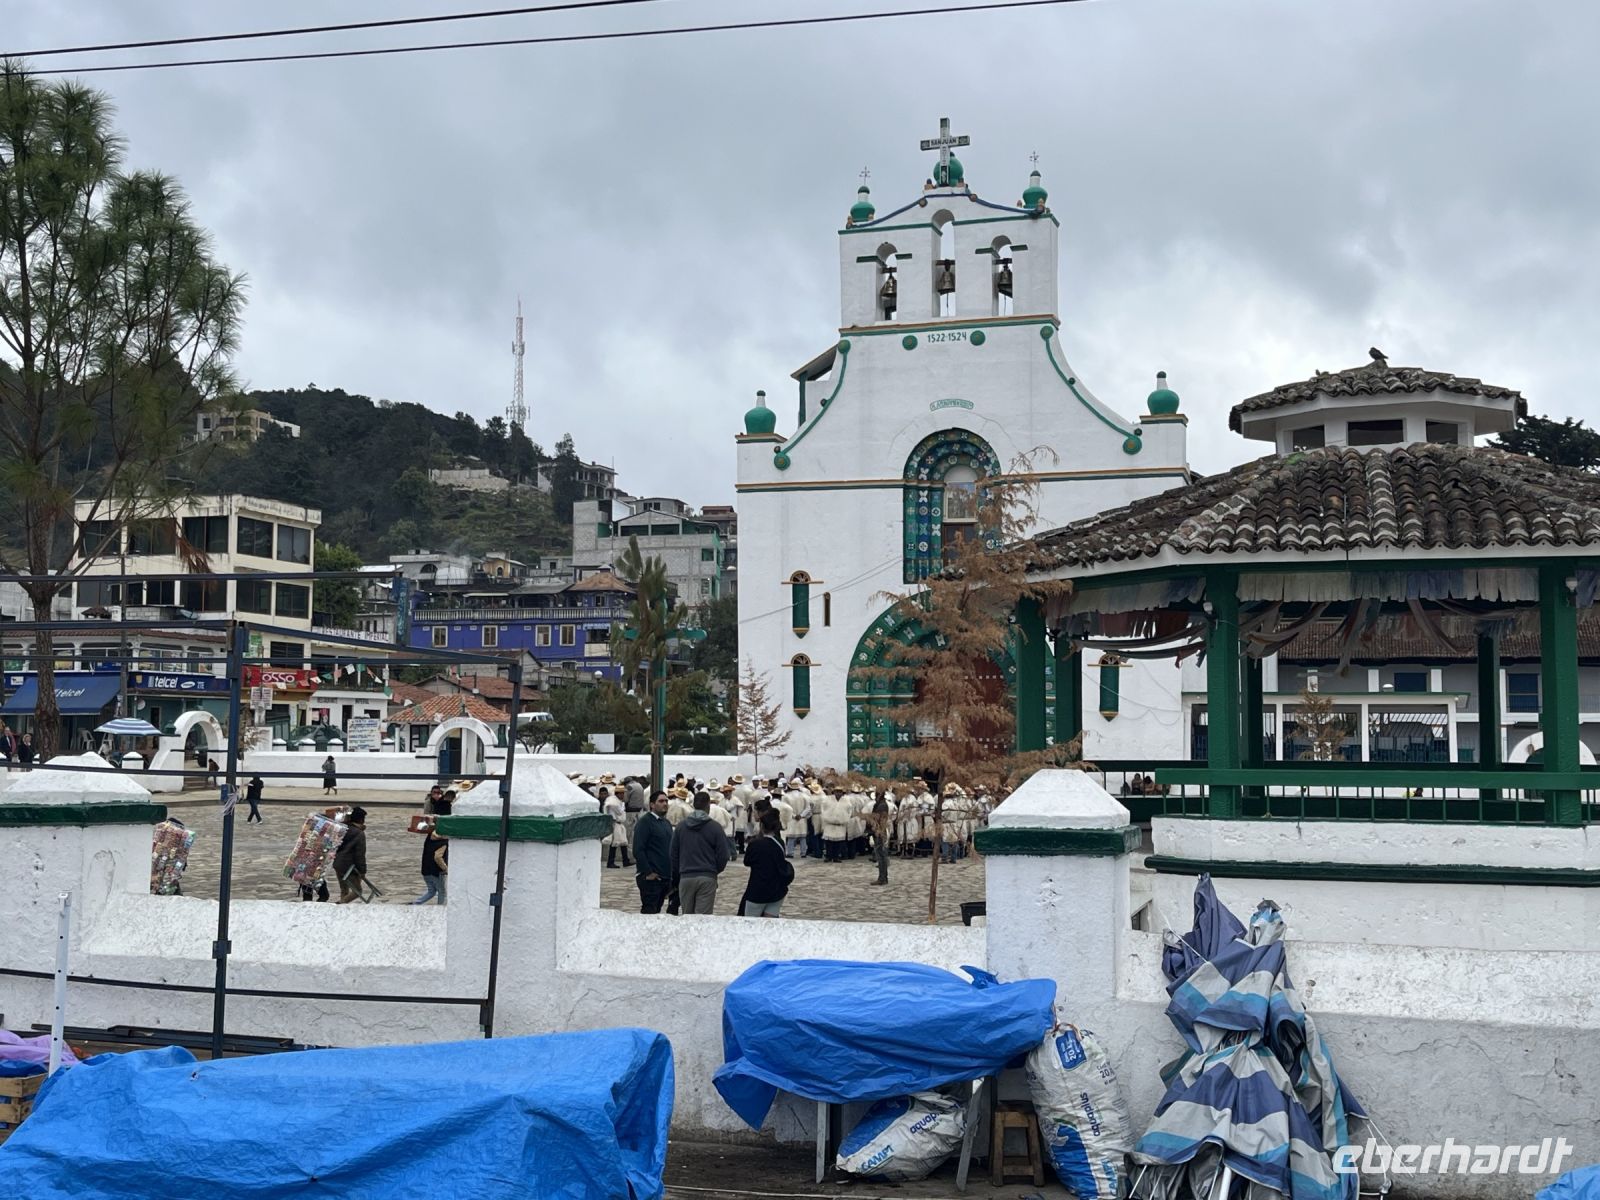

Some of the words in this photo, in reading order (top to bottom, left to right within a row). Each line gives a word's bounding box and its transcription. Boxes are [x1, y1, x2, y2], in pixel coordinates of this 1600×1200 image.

[154, 676, 179, 688] telcel
[910, 1112, 940, 1134] aquap
[1080, 1092, 1101, 1137] aquaplus
